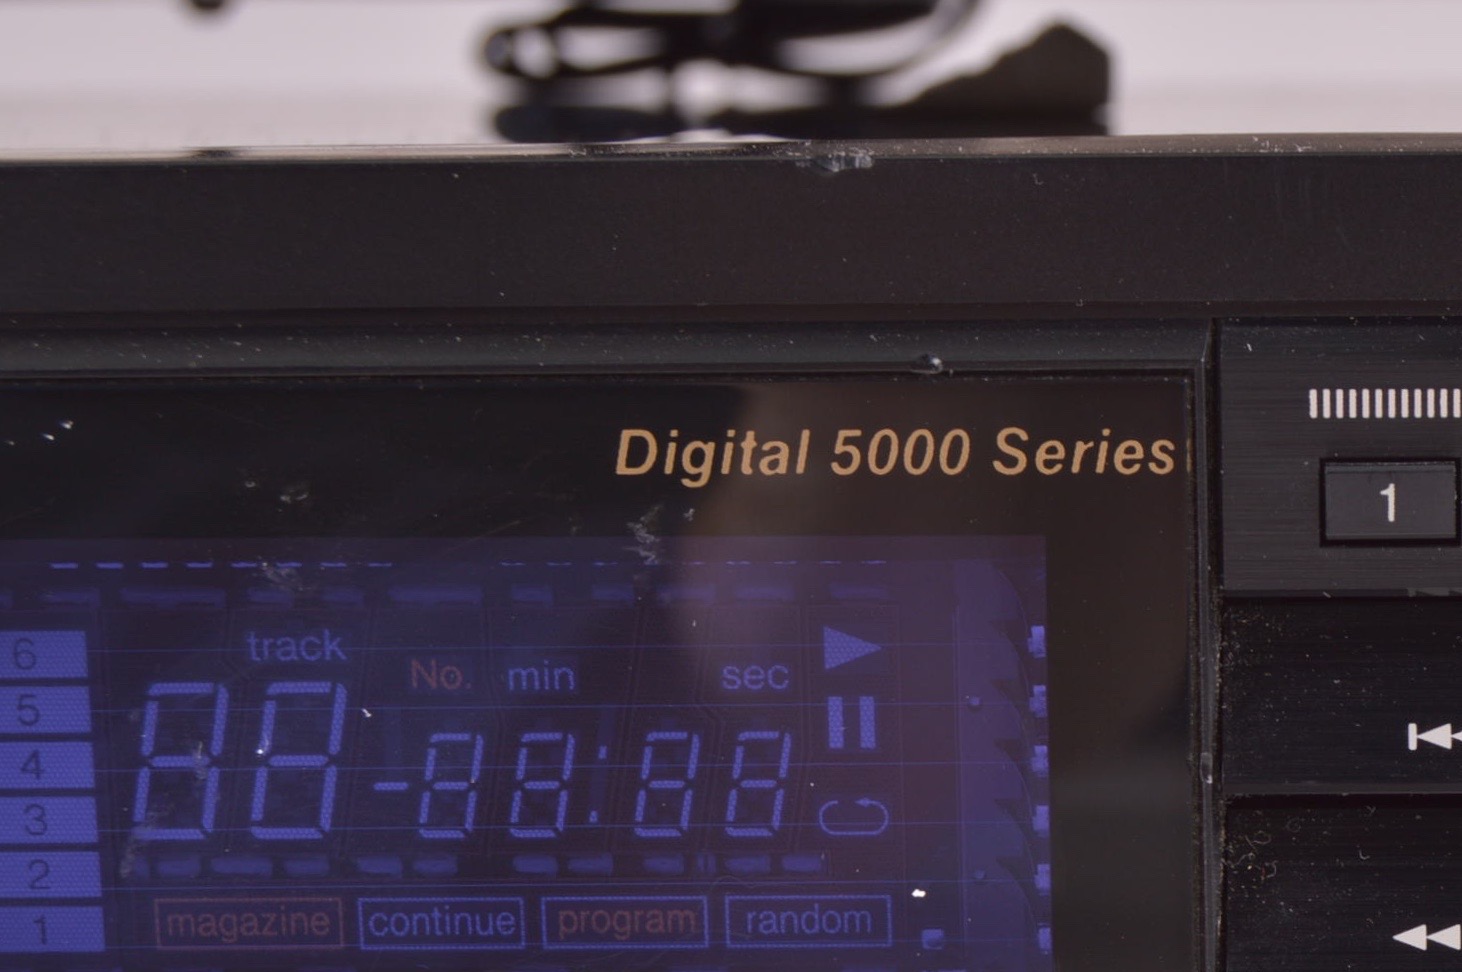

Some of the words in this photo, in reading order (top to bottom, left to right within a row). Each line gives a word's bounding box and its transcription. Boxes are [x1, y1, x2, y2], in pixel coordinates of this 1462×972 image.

[614, 428, 811, 488] Digital
[829, 428, 972, 476] 5000
[992, 426, 1176, 476] Series
[1378, 482, 1397, 523] 1
[13, 638, 38, 671] 6
[247, 629, 348, 662] track
[410, 659, 472, 690] No.
[507, 662, 576, 691] min
[721, 663, 791, 691] sec
[17, 693, 41, 725] 5
[20, 750, 43, 781] 4
[24, 804, 49, 837] 3
[27, 859, 51, 892] 2
[34, 916, 49, 945] 1
[166, 909, 331, 943] magazine
[368, 904, 516, 936] continue
[557, 905, 698, 939] program
[745, 902, 872, 934] random
